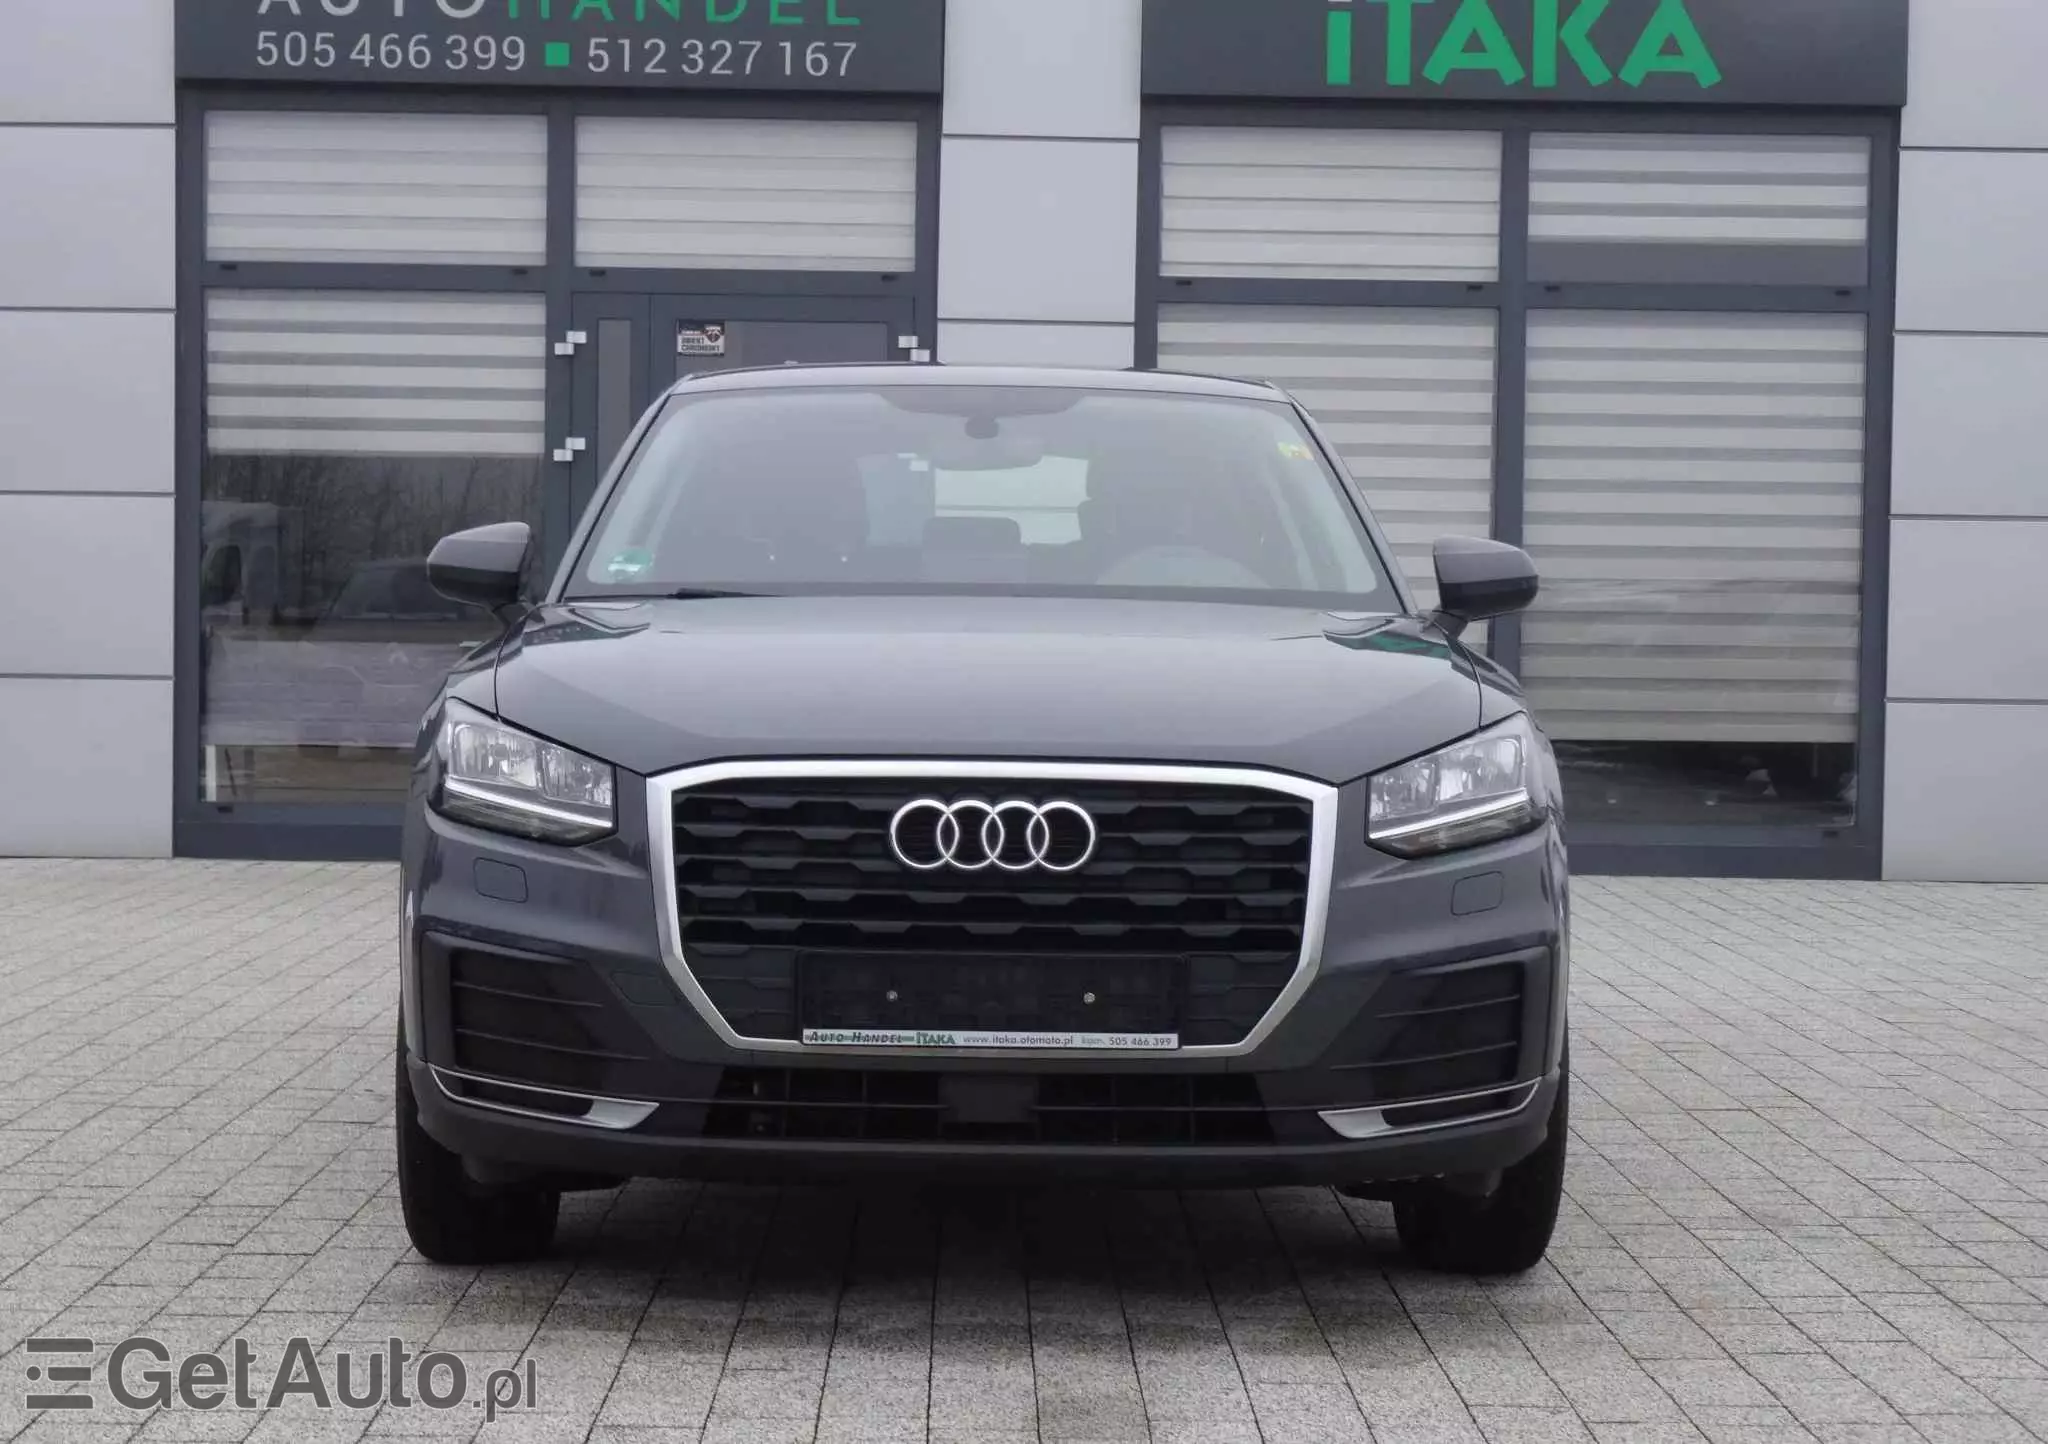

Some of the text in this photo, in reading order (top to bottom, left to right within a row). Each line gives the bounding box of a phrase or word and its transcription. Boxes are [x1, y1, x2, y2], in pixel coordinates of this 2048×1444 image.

[256, 30, 857, 77] 505 466 399 512 327 167
[1108, 1036, 1128, 1047] 505
[1131, 1037, 1150, 1047] 466
[1153, 1037, 1172, 1048] 399
